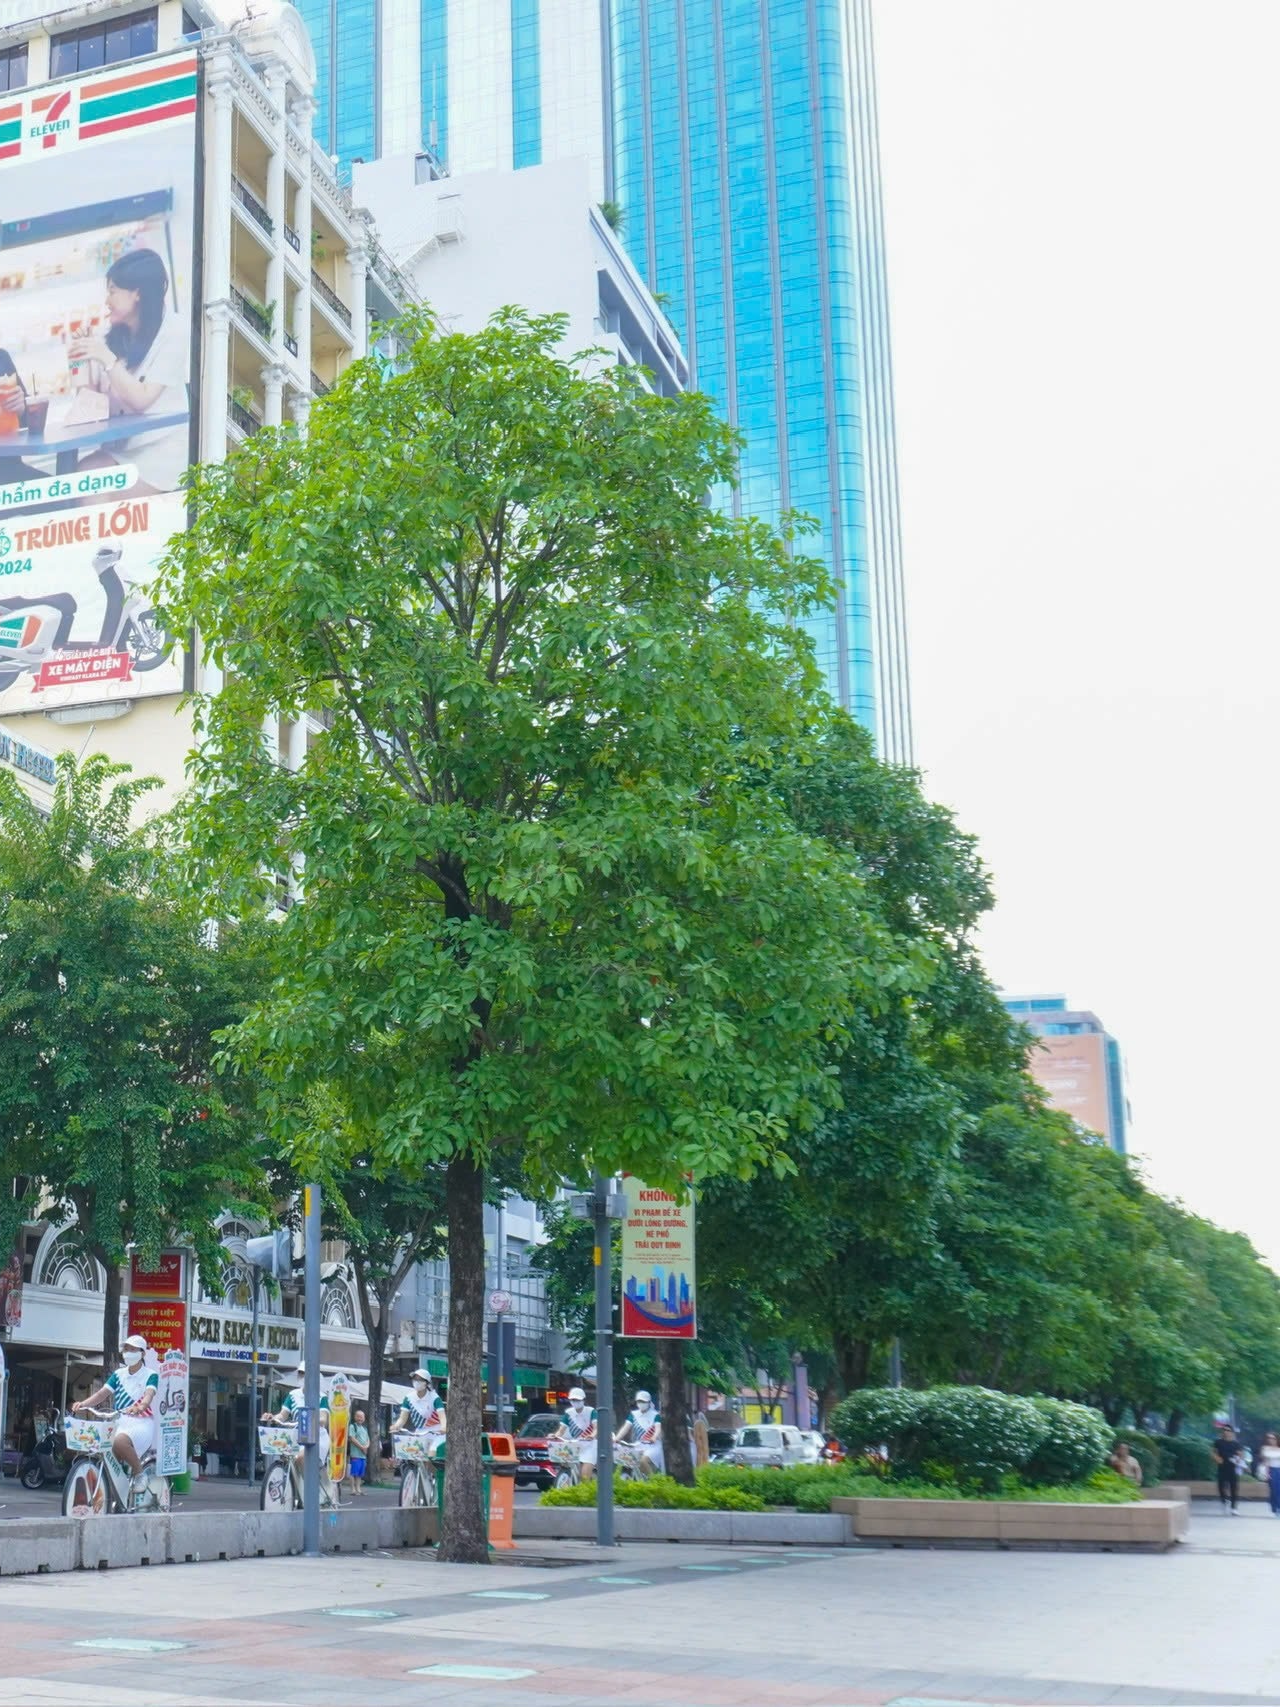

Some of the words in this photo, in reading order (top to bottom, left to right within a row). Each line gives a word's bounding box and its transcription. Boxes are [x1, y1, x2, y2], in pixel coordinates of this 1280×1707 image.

[31, 91, 71, 149] 7
[48, 480, 71, 498] đa
[78, 472, 128, 494] dạng
[14, 516, 91, 552] TRÚNG
[98, 502, 149, 538] LỚN
[48, 665, 63, 676] XE
[65, 659, 90, 674] MÁY
[93, 657, 121, 673] ĐIỆN
[642, 1208, 661, 1218] PHẠM
[190, 1316, 220, 1343] SCAR
